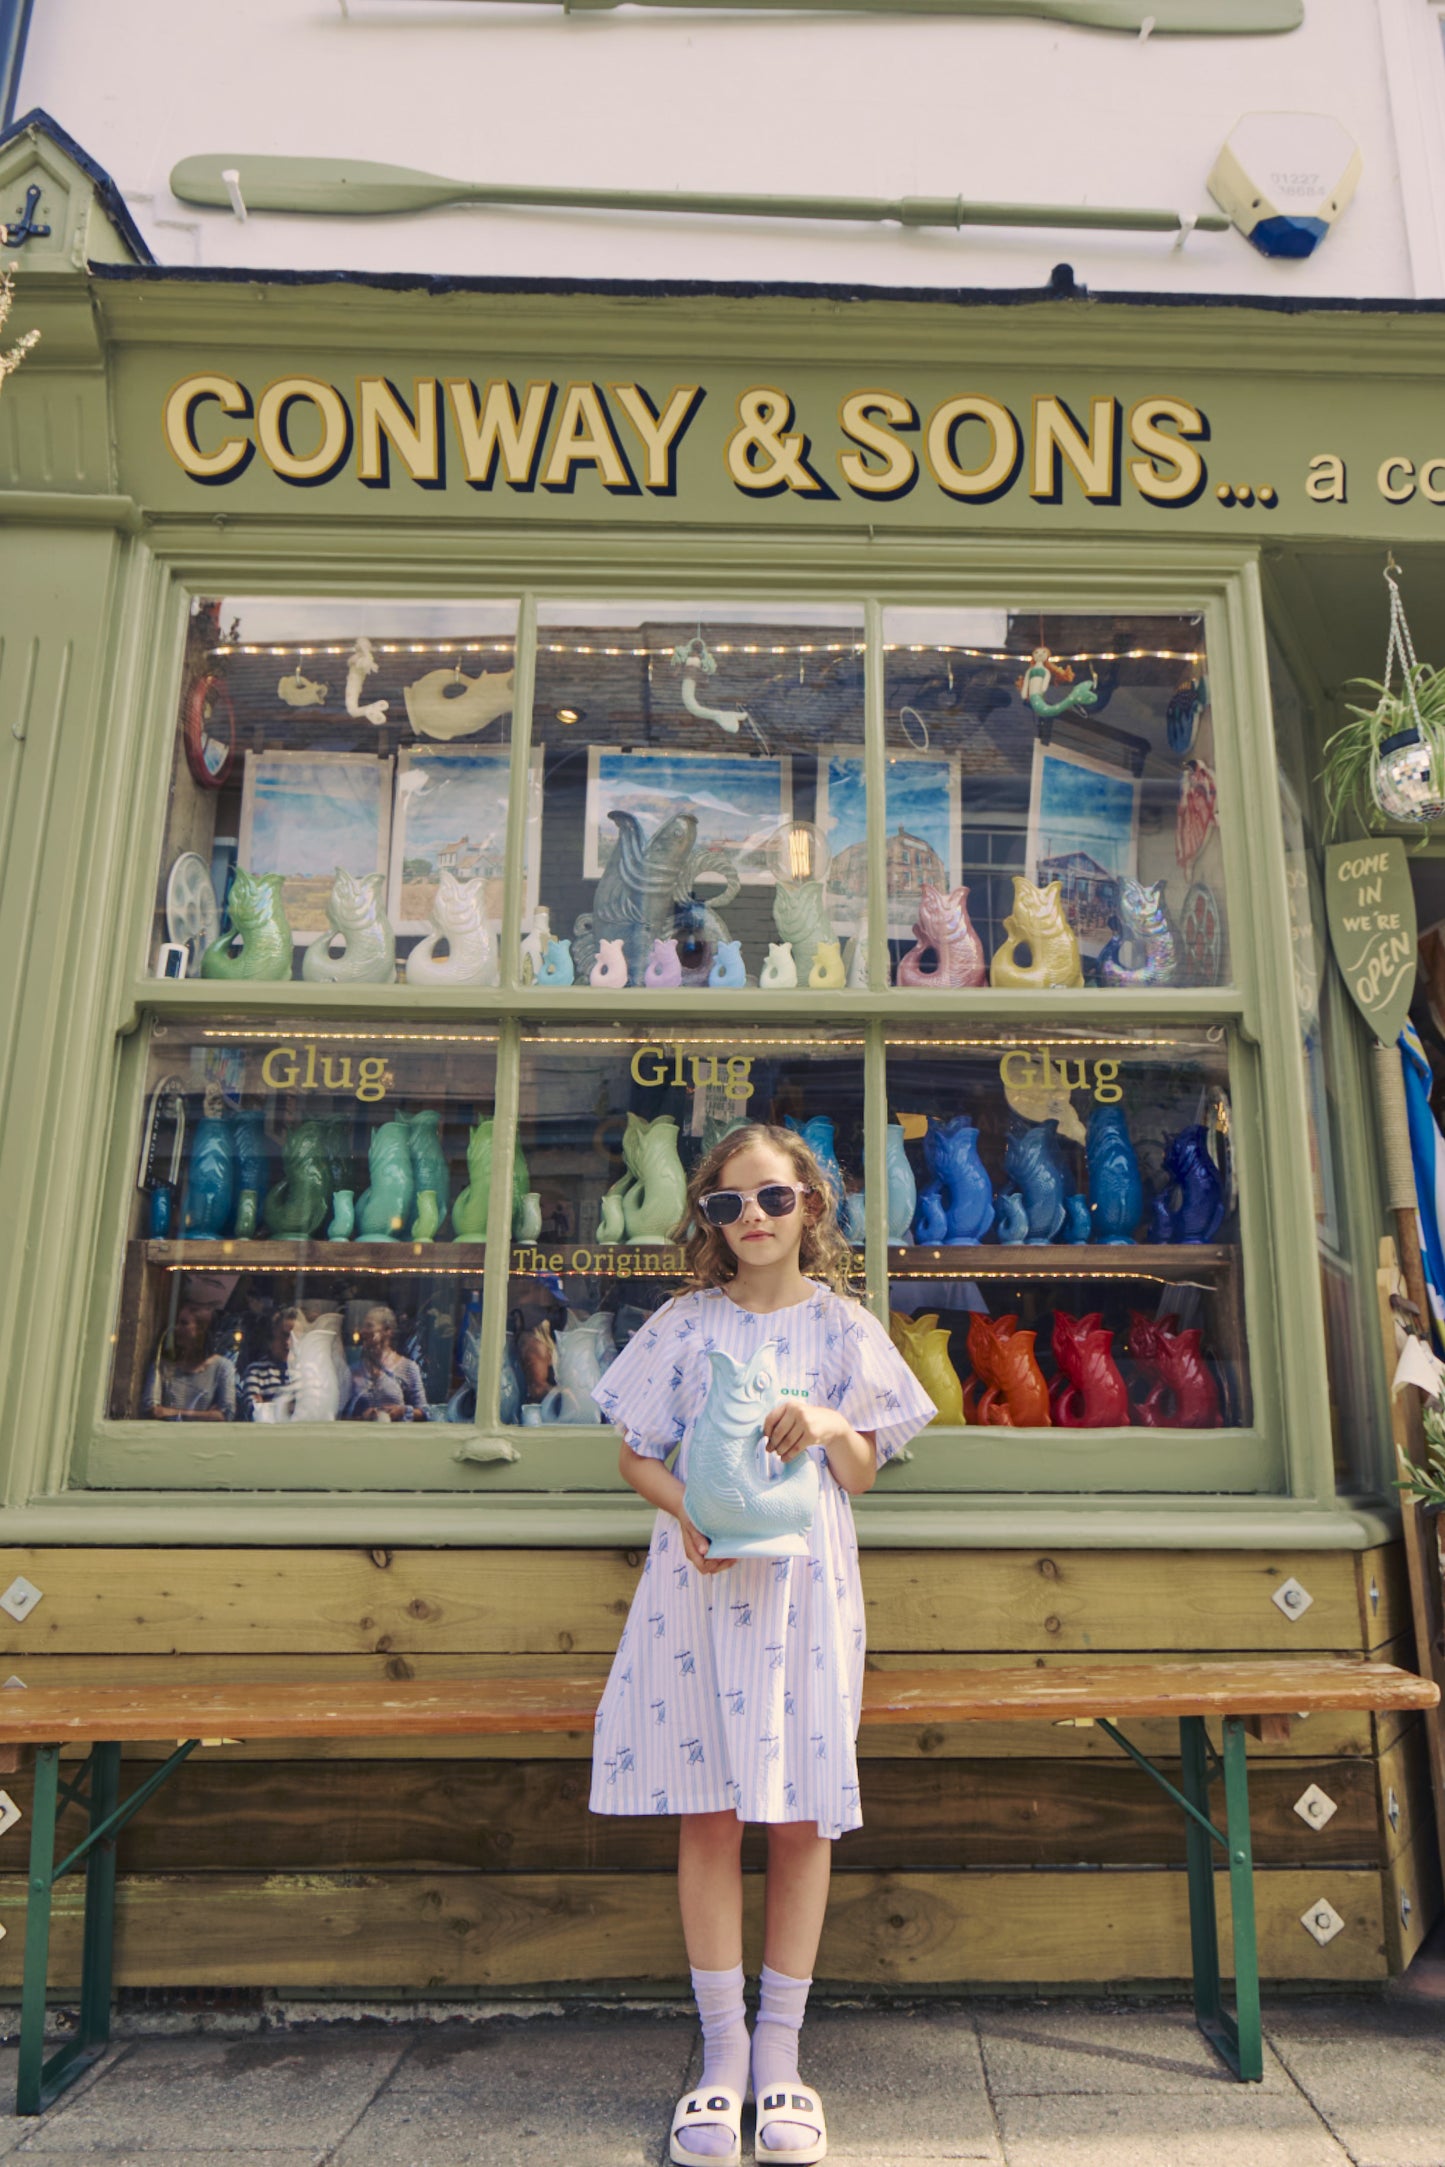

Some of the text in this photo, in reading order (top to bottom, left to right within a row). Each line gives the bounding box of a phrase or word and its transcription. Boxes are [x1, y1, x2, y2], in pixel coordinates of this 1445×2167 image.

[162, 371, 1445, 510] CONWAY & SONS... a co
[1337, 852, 1390, 882] COME
[1357, 877, 1384, 908] IN
[1356, 931, 1411, 1004] OPEN
[261, 1044, 390, 1103] Glug
[630, 1042, 756, 1100] Glug
[999, 1046, 1124, 1104] Glug
[512, 1247, 565, 1273] The
[571, 1247, 688, 1279] Original
[781, 1388, 809, 1397] OUD
[687, 2096, 730, 2114] LO
